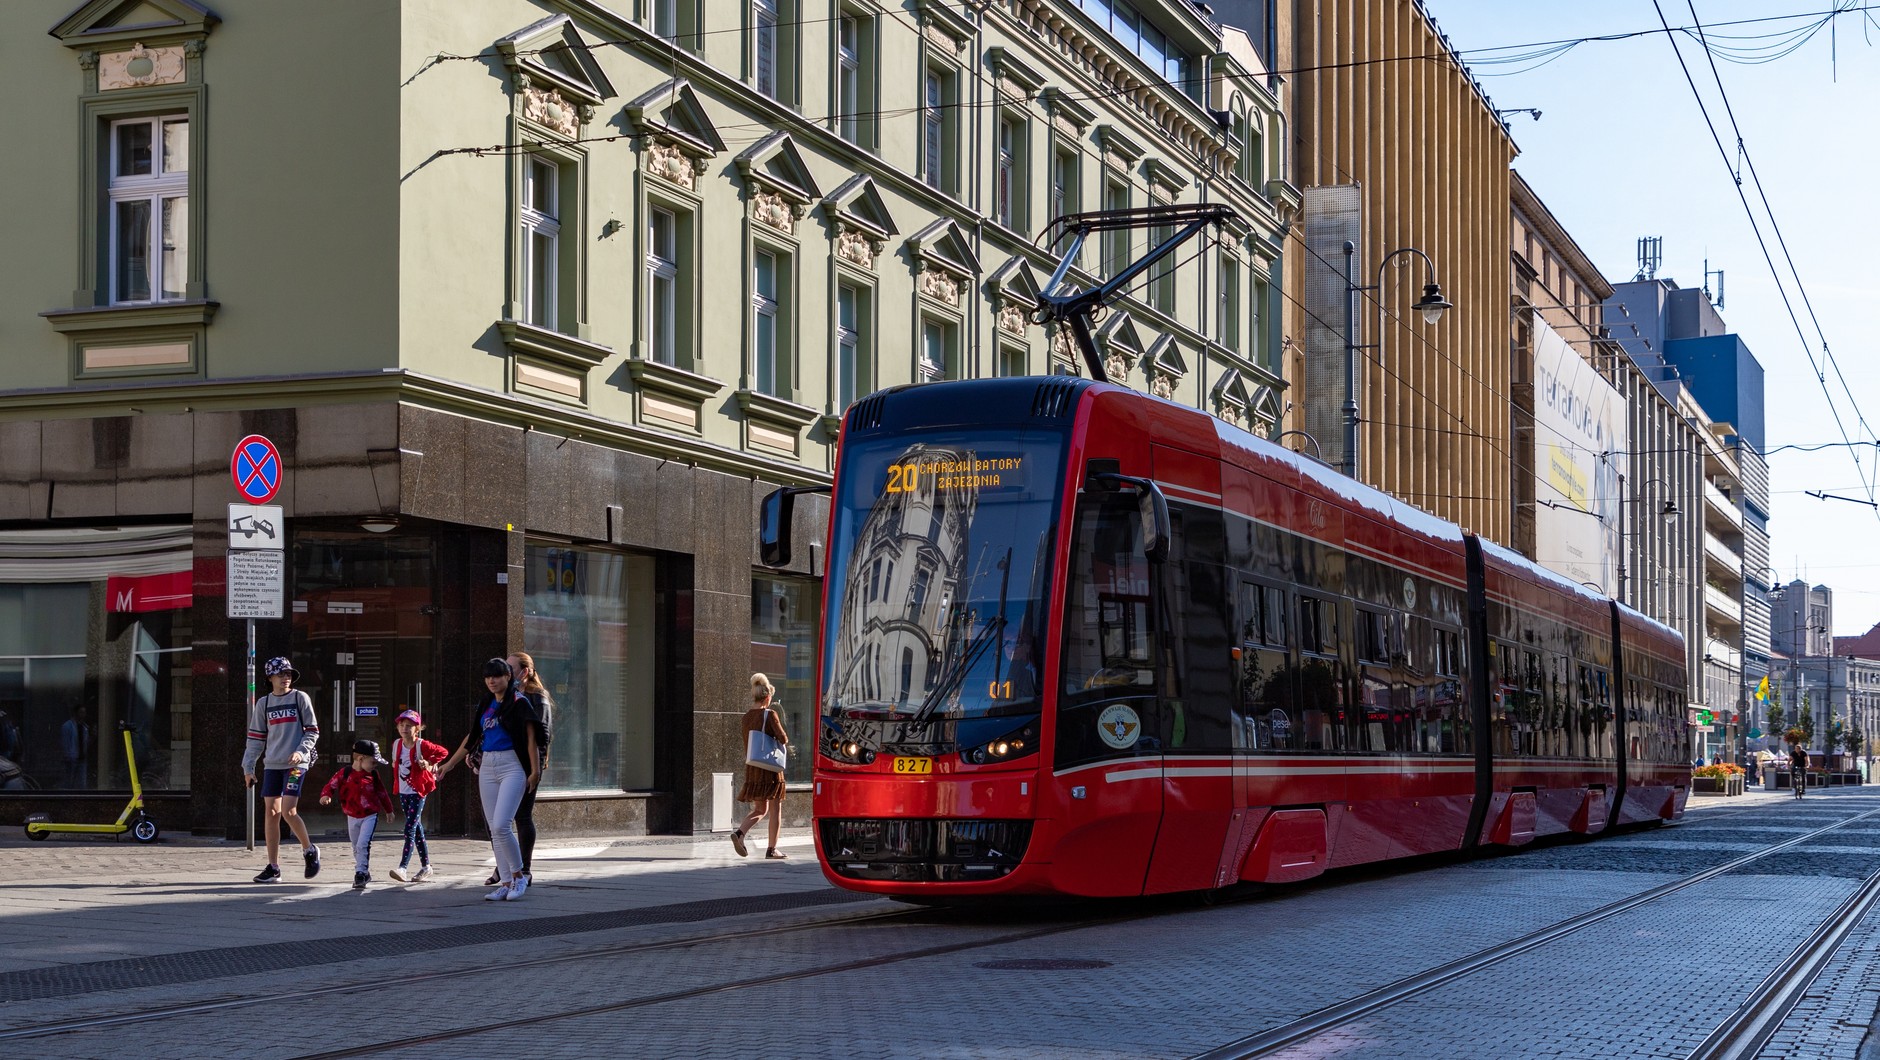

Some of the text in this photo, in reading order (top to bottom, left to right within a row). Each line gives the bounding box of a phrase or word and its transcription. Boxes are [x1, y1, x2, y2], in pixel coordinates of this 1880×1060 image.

[975, 458, 1022, 471] BATORY
[887, 464, 918, 492] 20
[938, 475, 1000, 489] ZAJEZDNIA
[988, 680, 1011, 699] 01
[896, 759, 930, 773] 827
